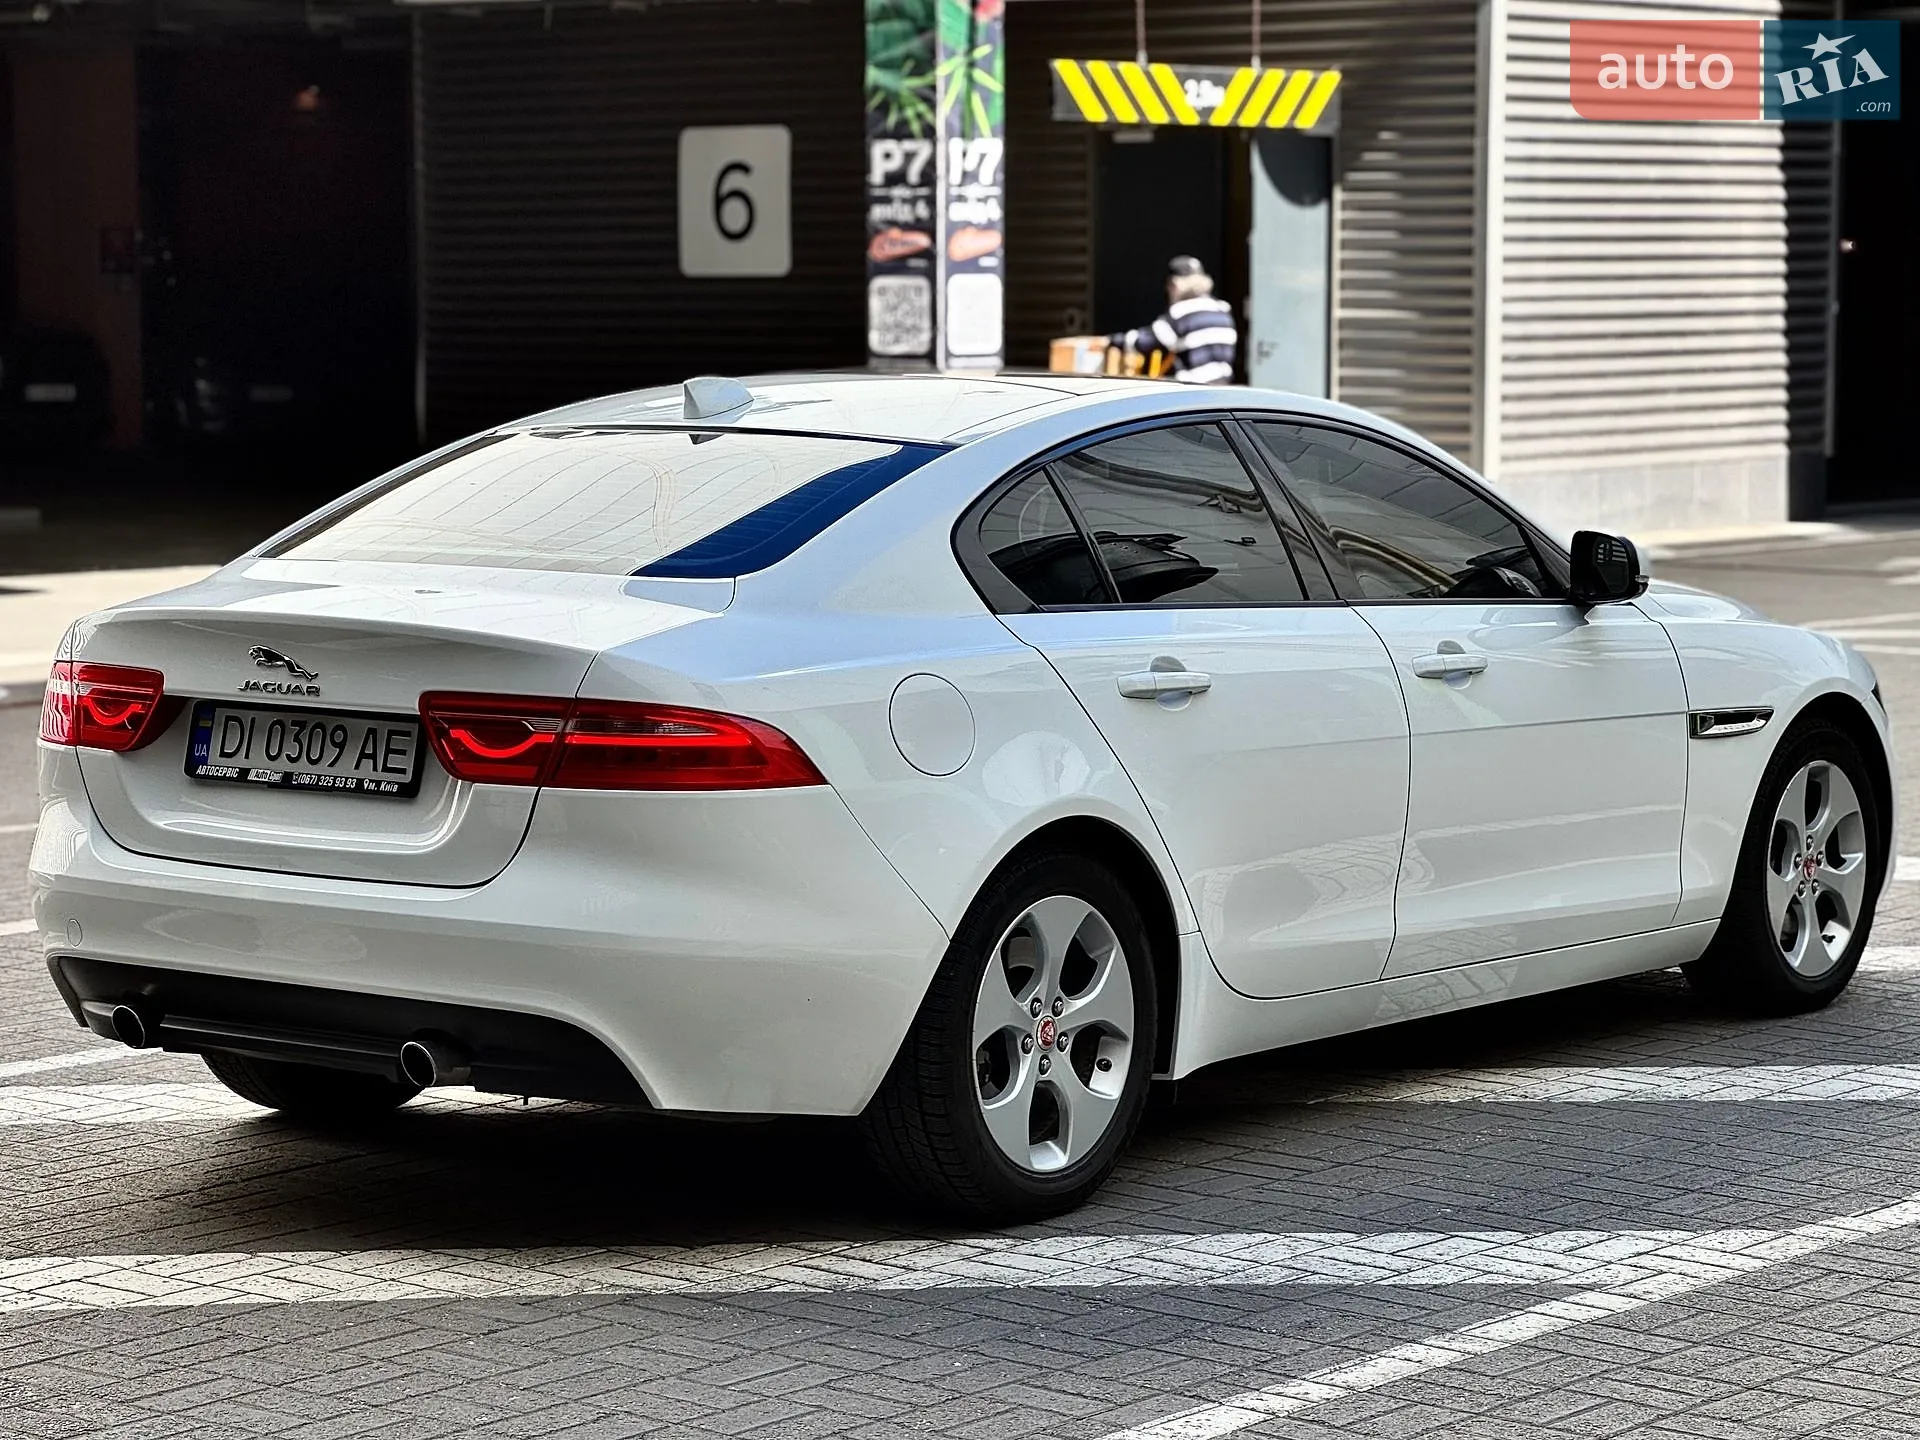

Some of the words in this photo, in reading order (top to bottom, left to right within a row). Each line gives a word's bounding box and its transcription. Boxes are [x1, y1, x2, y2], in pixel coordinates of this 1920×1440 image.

[869, 138, 933, 186] P7
[713, 161, 756, 241] 6
[237, 679, 321, 697] JAGUAR
[194, 743, 208, 757] UA
[218, 714, 256, 760] DI
[263, 718, 348, 768] 0309
[353, 726, 412, 775] AE
[196, 765, 240, 778] АВТОСЕРВІС
[297, 773, 318, 785] (067)
[318, 776, 334, 786] 325
[335, 777, 346, 787] 93
[346, 778, 357, 789] 93
